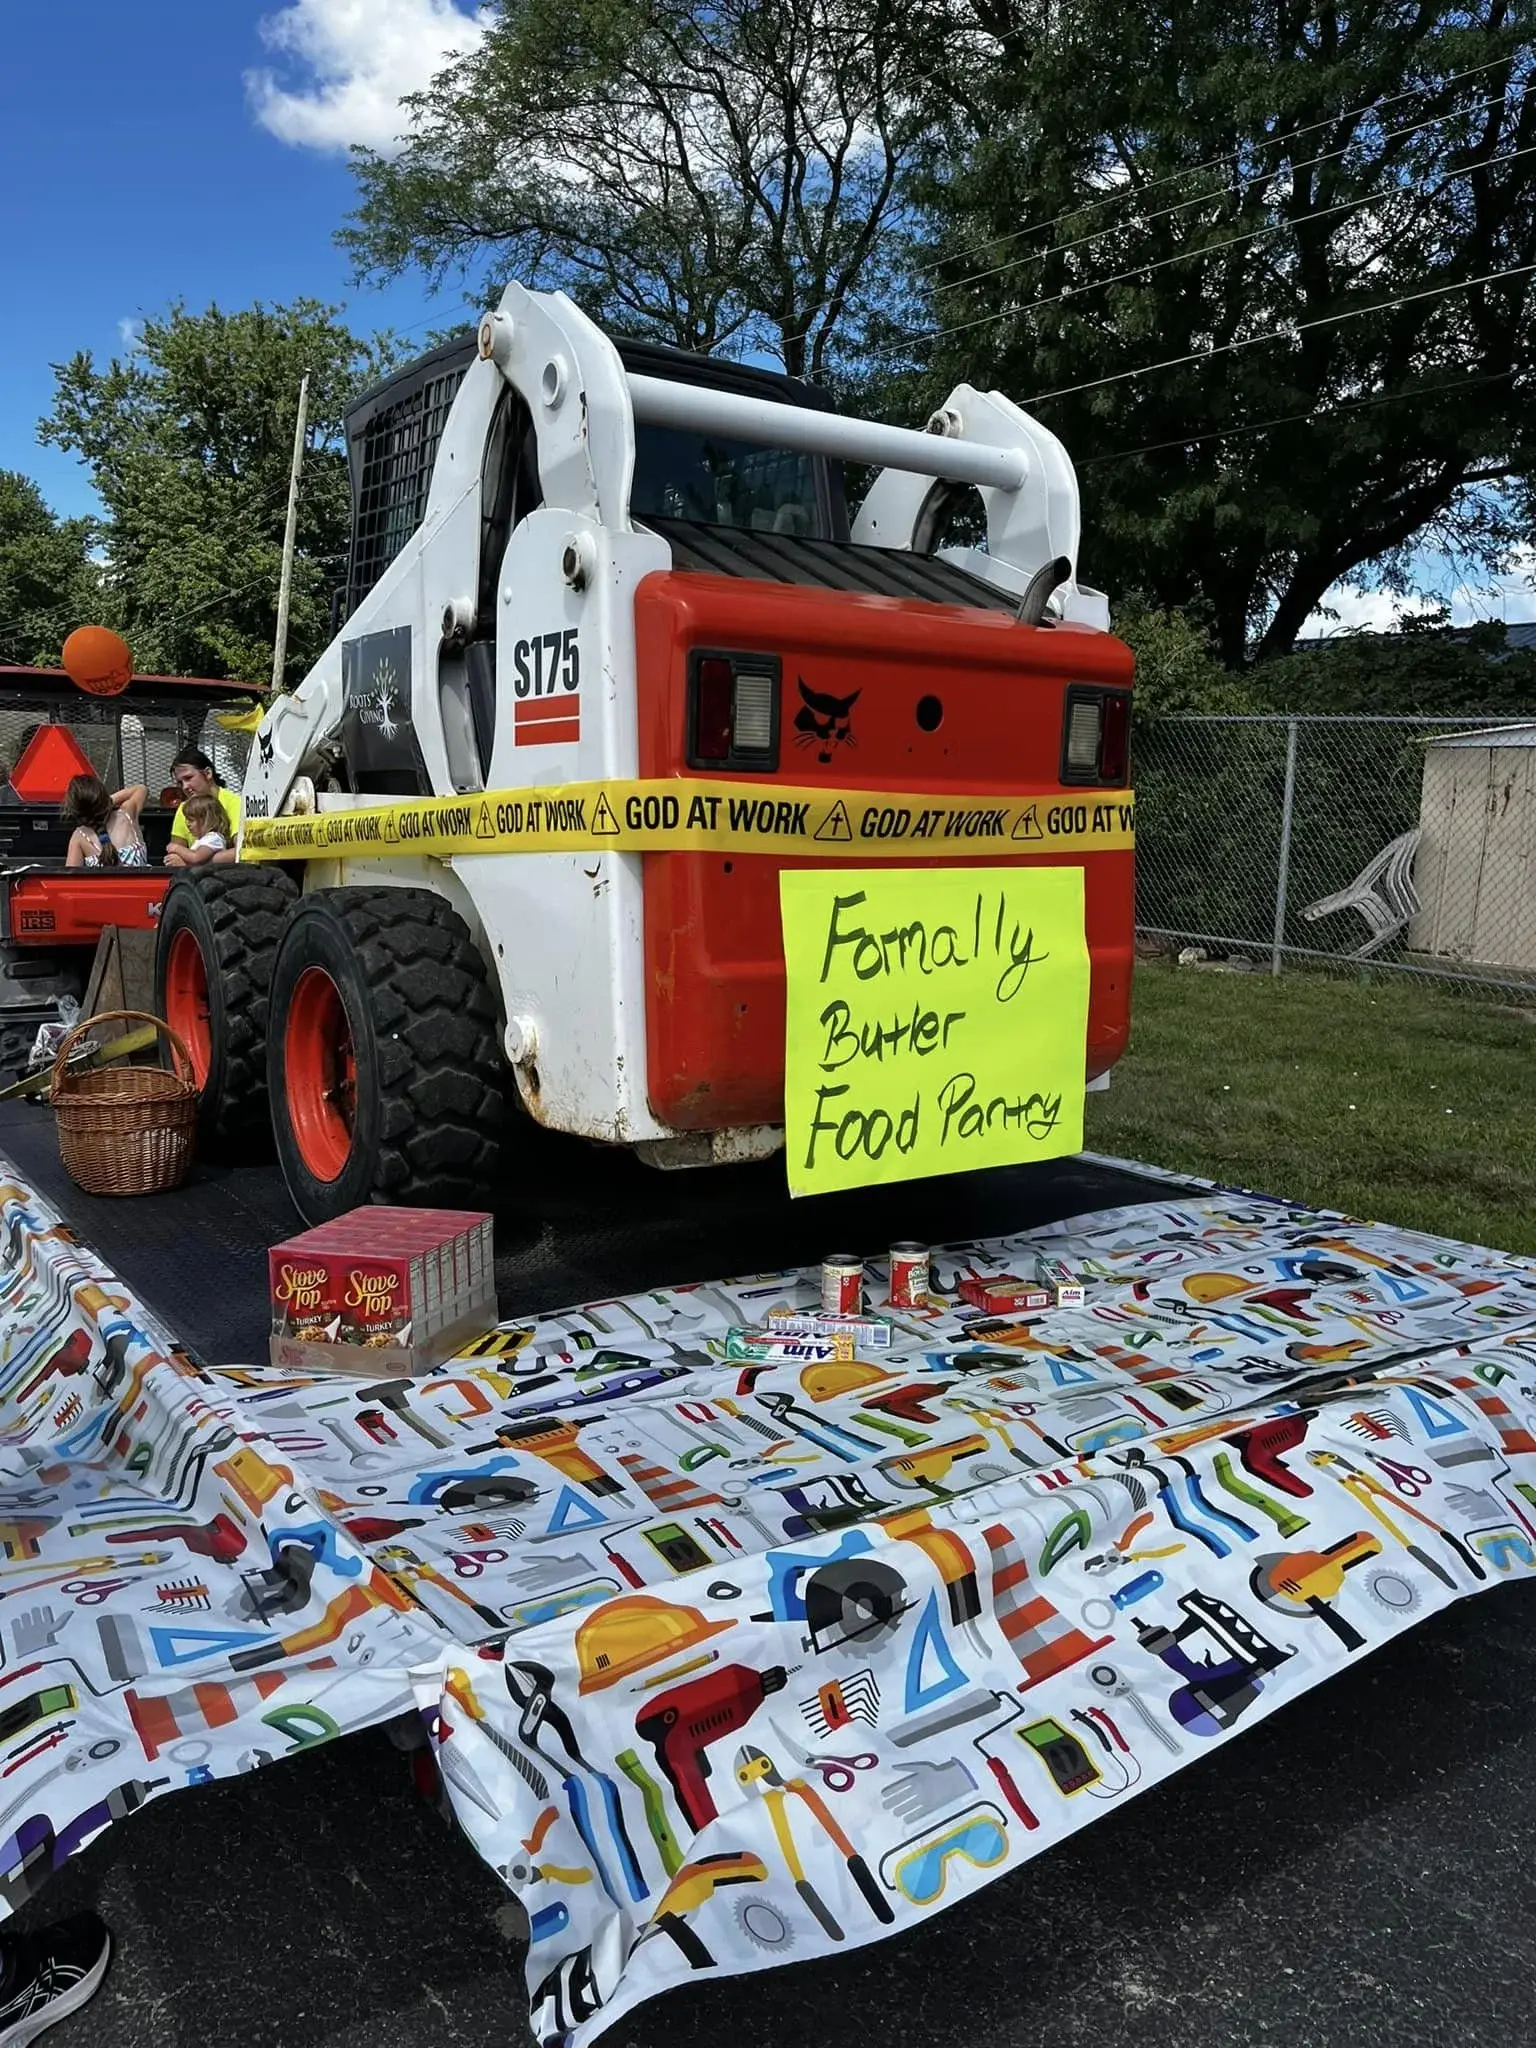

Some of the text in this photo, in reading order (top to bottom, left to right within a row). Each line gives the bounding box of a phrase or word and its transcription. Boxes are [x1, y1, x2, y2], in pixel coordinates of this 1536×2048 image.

[514, 628, 579, 698] S175
[349, 694, 371, 709] ROOTS
[245, 794, 269, 818] Bobcat
[327, 820, 344, 843] GOD
[343, 818, 354, 842] AT
[354, 815, 382, 841] WORK
[400, 812, 420, 839] GOD
[422, 810, 435, 837] AT
[436, 807, 472, 837] WORK
[497, 803, 523, 834] GOD
[526, 801, 543, 832] AT
[545, 799, 587, 832] WORK
[625, 796, 679, 829] GOD
[686, 796, 722, 830] AT
[728, 798, 810, 835] WORK
[860, 807, 912, 838] GOD
[910, 810, 945, 838] AT
[944, 809, 1010, 838] WORK
[1047, 806, 1087, 834] GOD
[1092, 804, 1115, 832] AT
[21, 917, 54, 929] IRS
[819, 890, 1050, 1002] Formally
[818, 1000, 966, 1072] Butler
[804, 1072, 1062, 1169] Food Pantry
[275, 1264, 328, 1300] Stove
[345, 1270, 399, 1306] Stove
[293, 1288, 321, 1310] Top
[363, 1294, 392, 1317] Top
[296, 1315, 322, 1326] TURKEY
[365, 1321, 393, 1333] TURKEY
[783, 1345, 834, 1360] Aim
